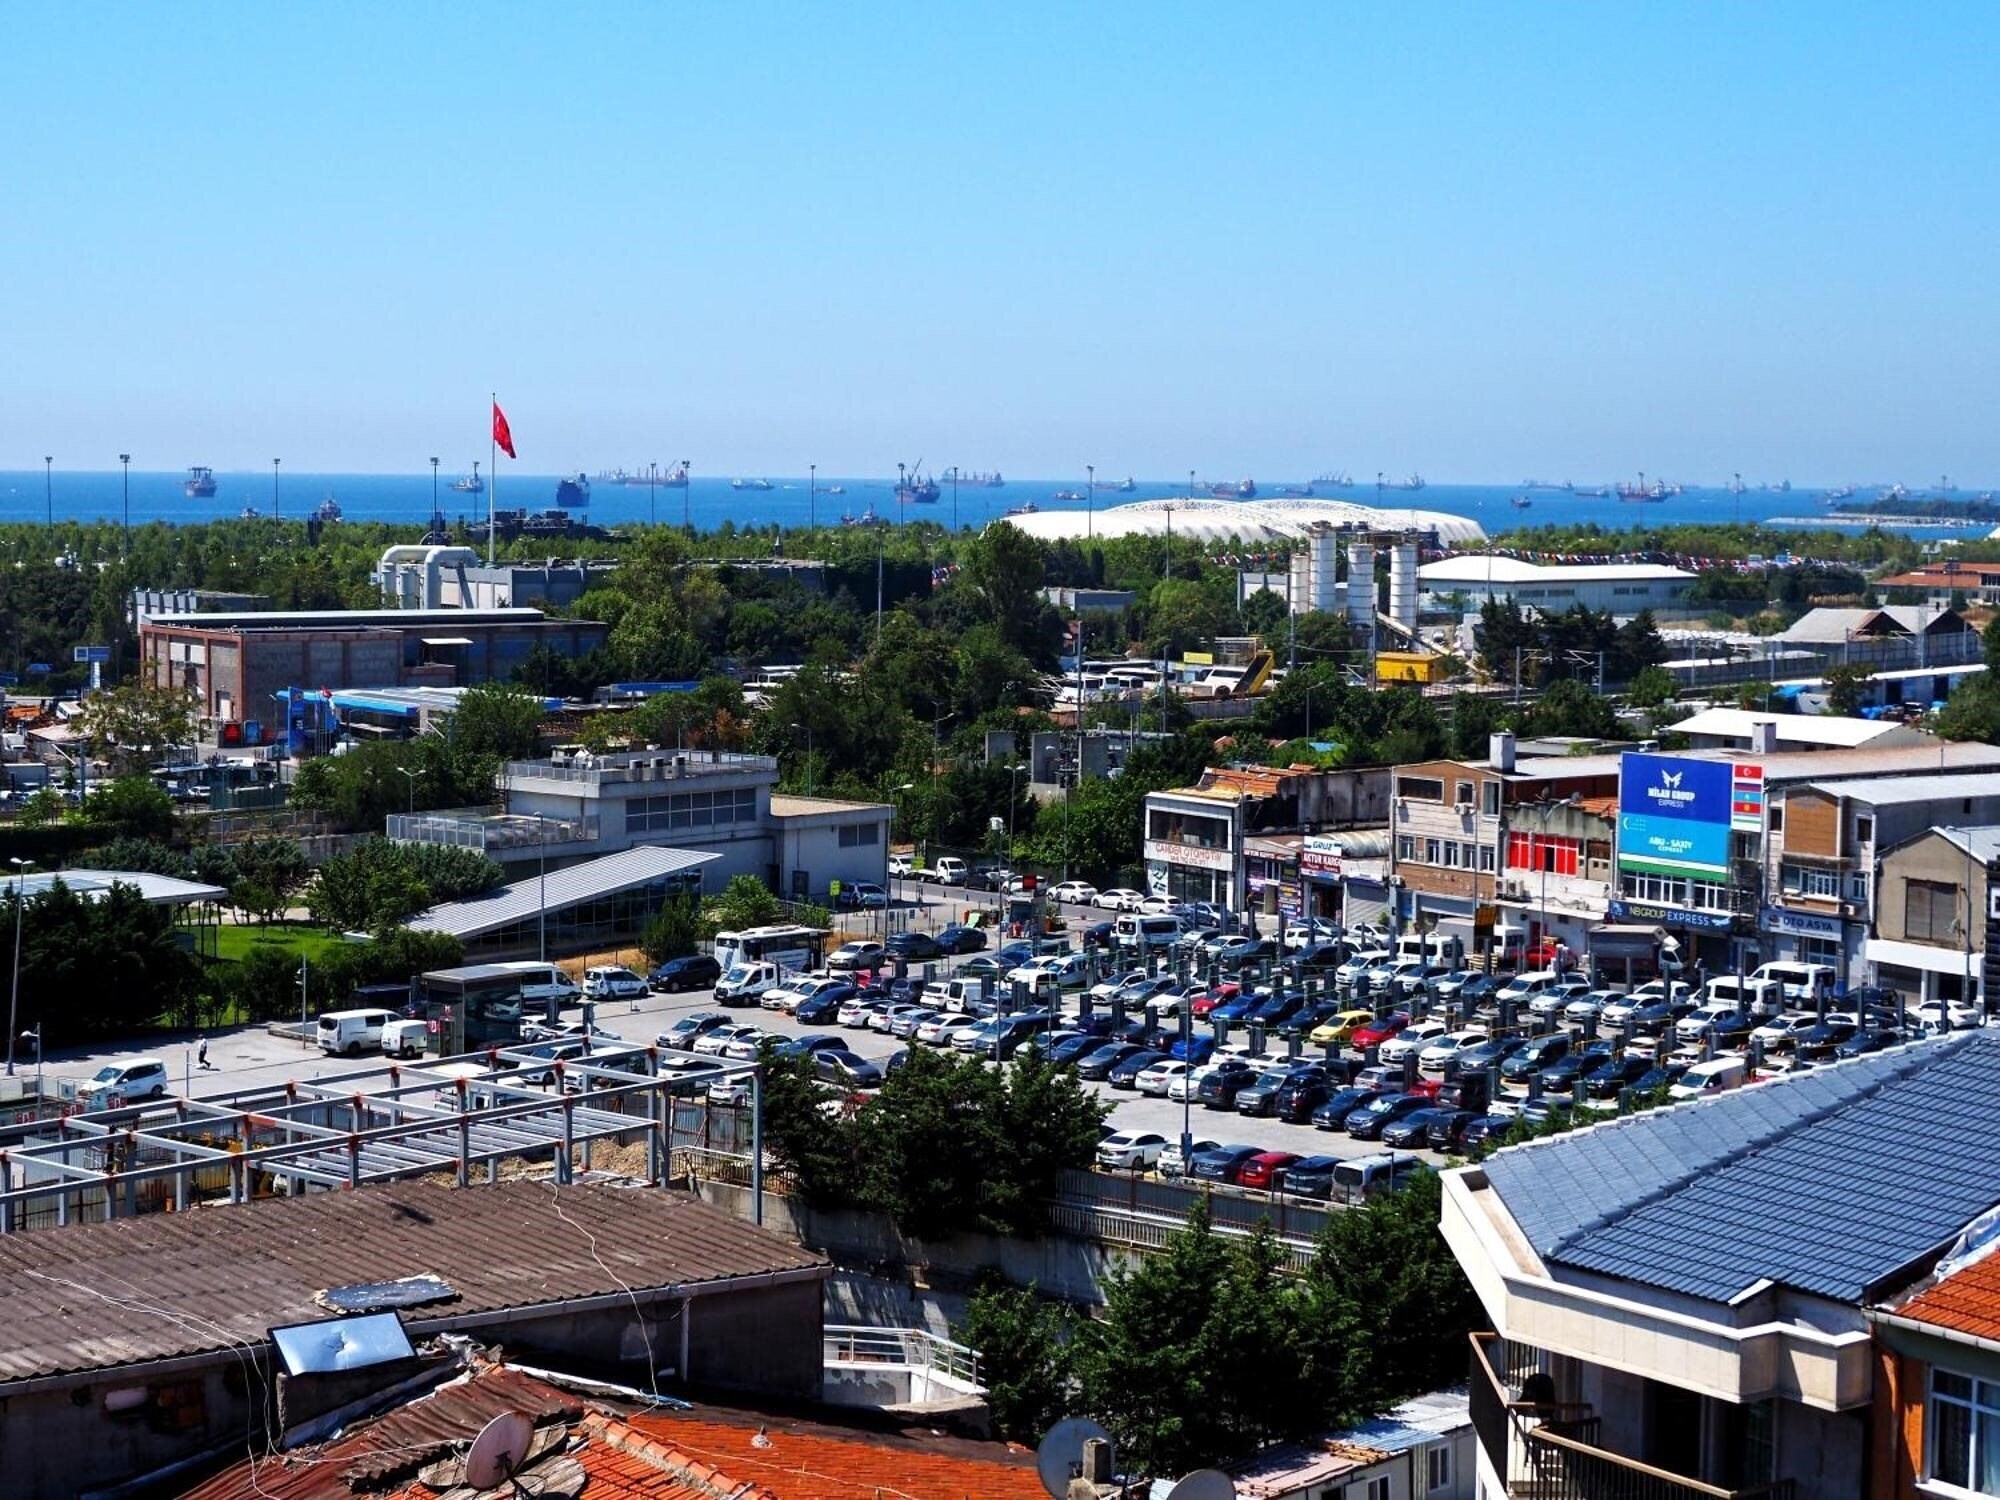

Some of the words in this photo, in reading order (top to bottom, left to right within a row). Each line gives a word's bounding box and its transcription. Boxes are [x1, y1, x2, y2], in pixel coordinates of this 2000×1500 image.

[1671, 790, 1696, 801] GROUP
[1658, 798, 1685, 808] EXPRESS
[1667, 911, 1710, 926] EXPRESS
[1783, 916, 1805, 927] OTO
[1806, 919, 1833, 931] ASYA
